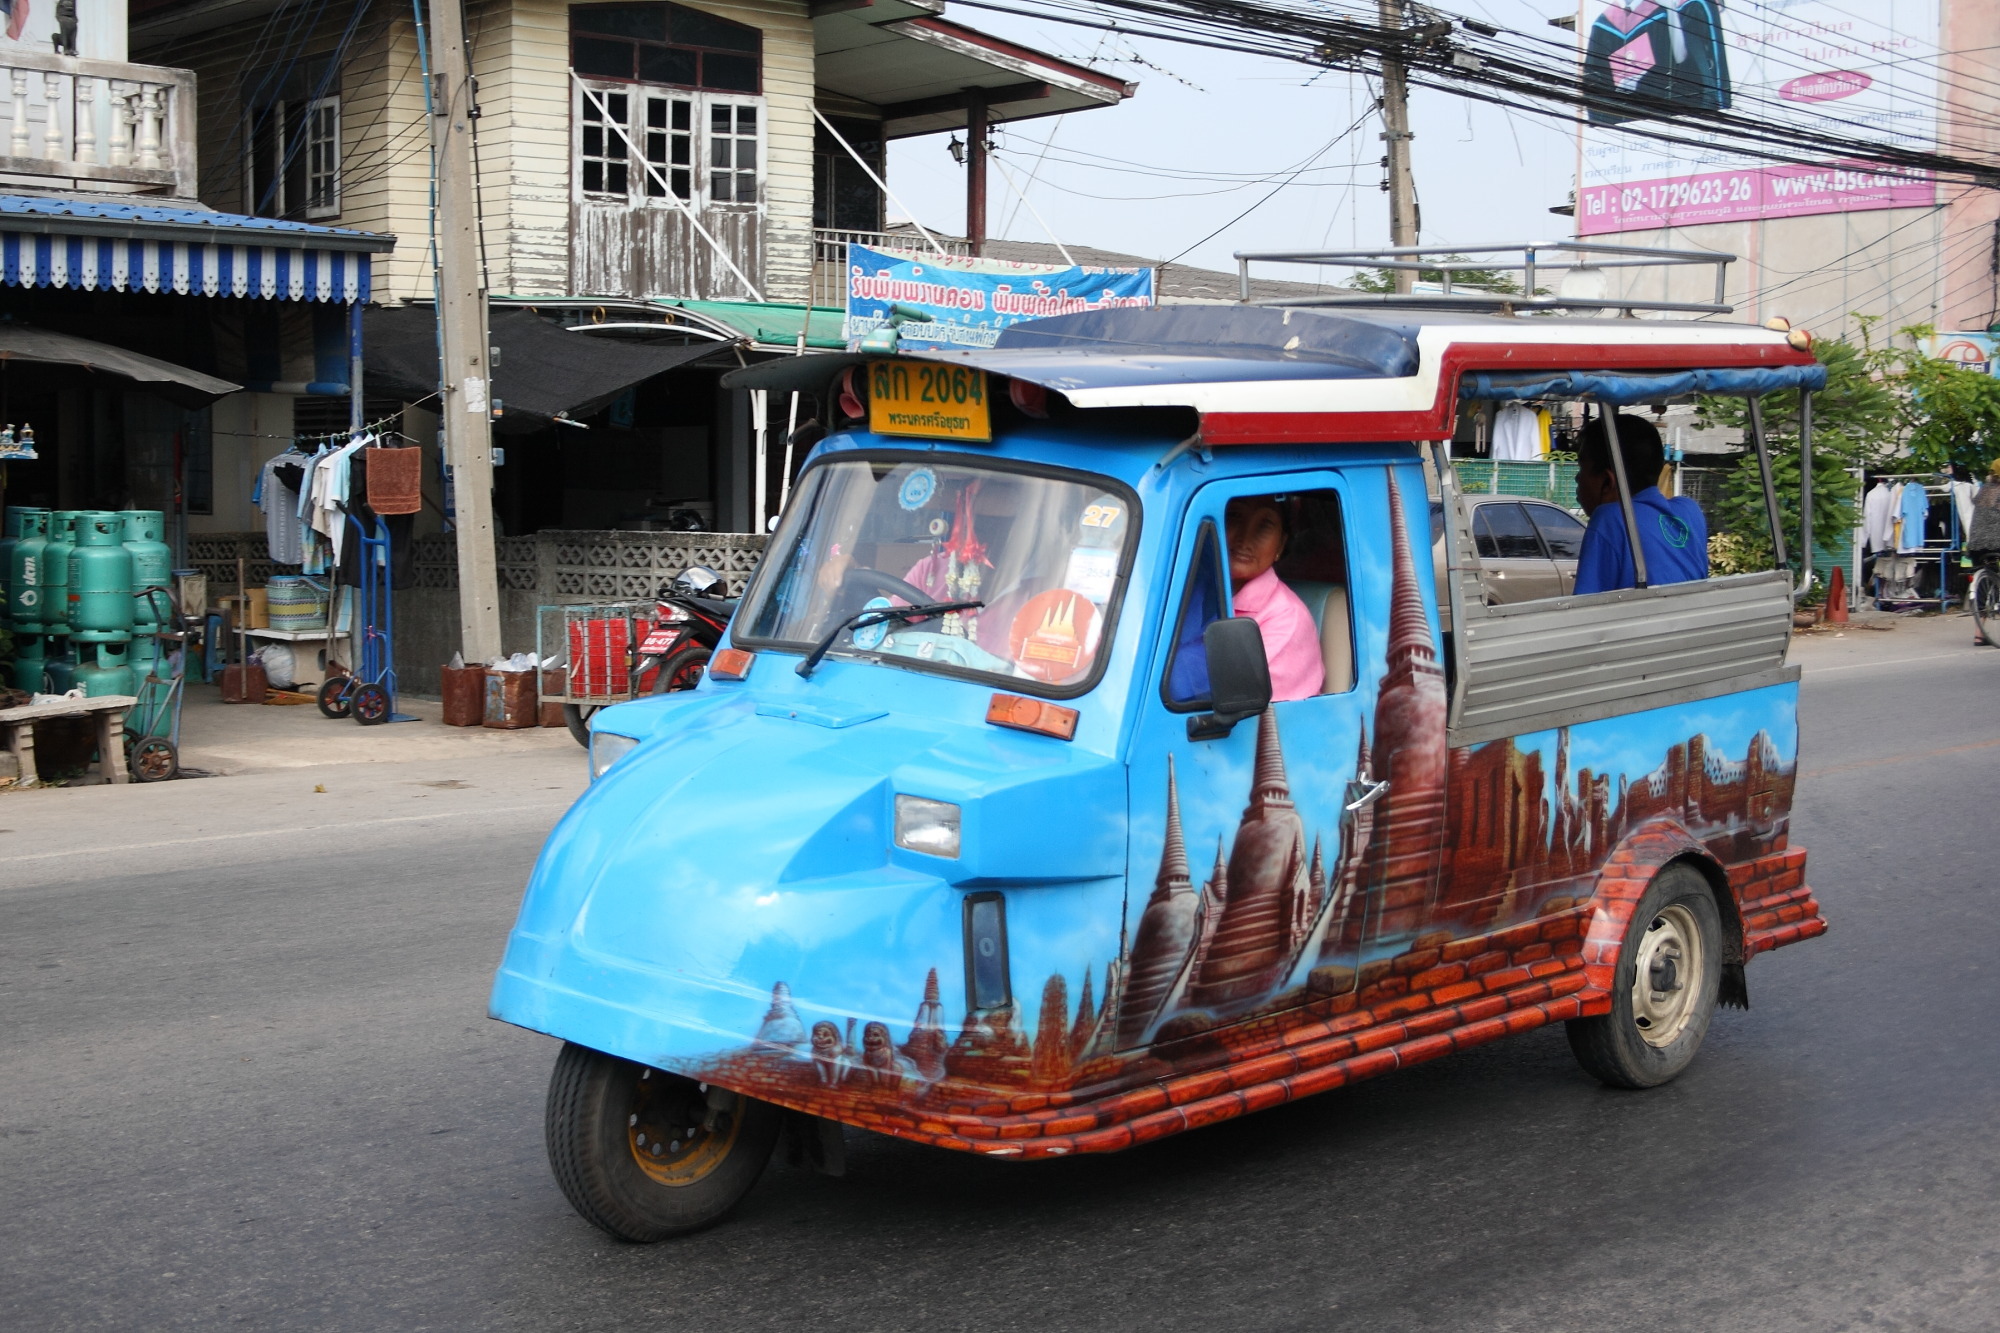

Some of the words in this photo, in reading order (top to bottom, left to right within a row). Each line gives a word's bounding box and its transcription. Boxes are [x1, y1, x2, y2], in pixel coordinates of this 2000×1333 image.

[1871, 35, 1919, 53] BSC
[1585, 190, 1607, 216] Tel
[1621, 176, 1752, 213] 02-1729623-26
[919, 366, 983, 406] 2064
[888, 411, 971, 433] พระนครศรีอยุธยา
[1082, 504, 1121, 528] 27
[1086, 567, 1111, 578] 2554
